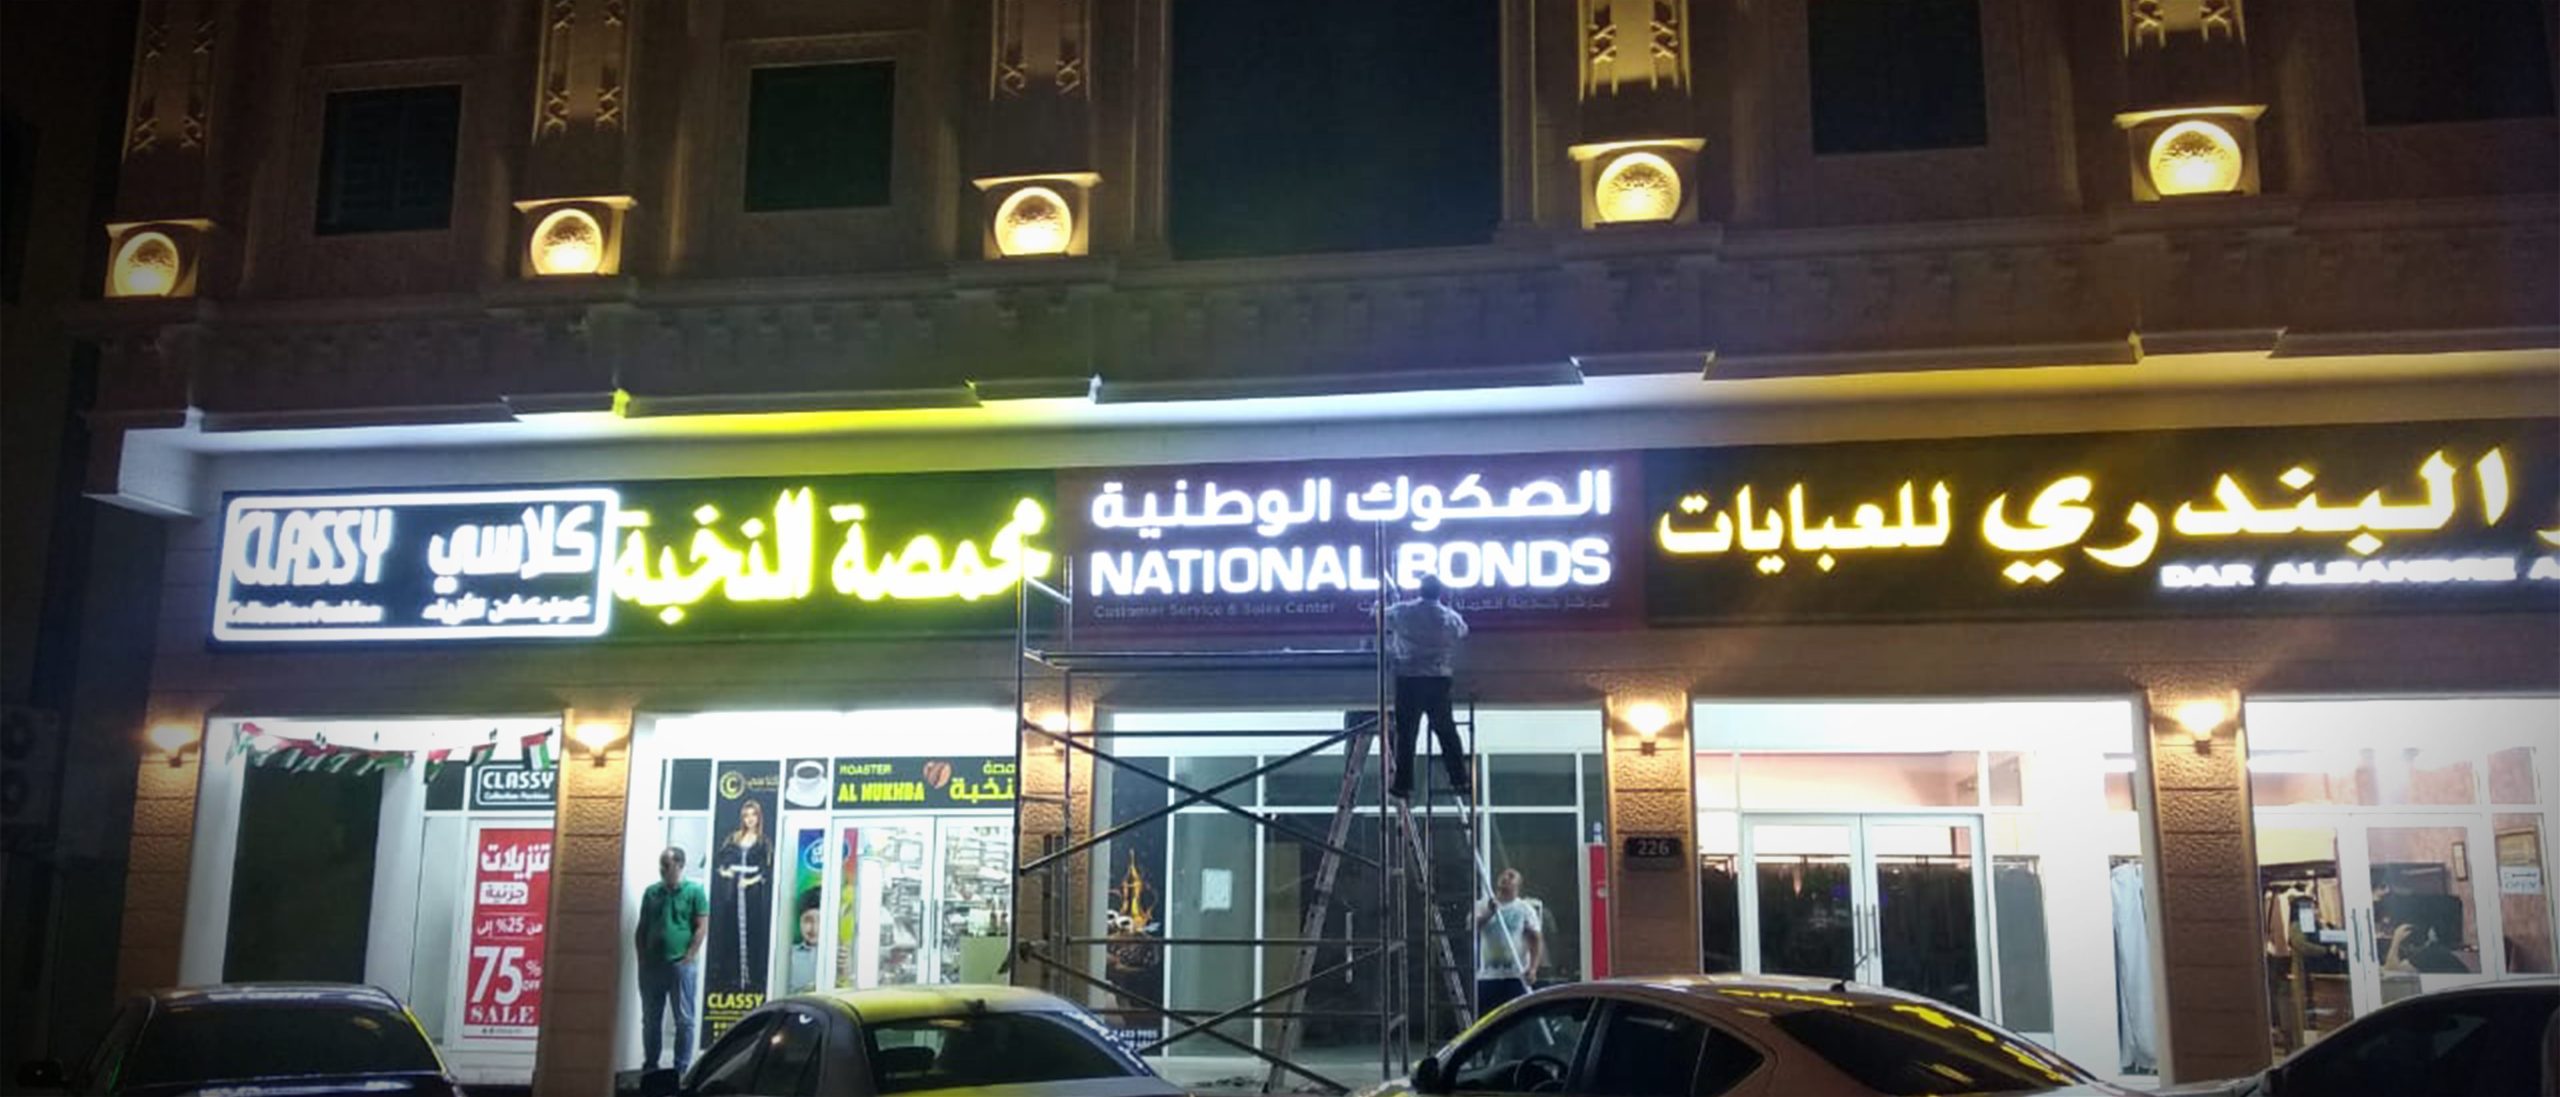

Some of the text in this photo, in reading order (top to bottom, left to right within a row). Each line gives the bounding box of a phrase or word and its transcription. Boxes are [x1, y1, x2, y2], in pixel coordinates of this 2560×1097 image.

[1091, 469, 1612, 539] الصكوك الوطنية
[1658, 447, 2510, 584] البندري للعبايات
[232, 508, 394, 586] CLASSY
[427, 505, 596, 594] كلاسي
[613, 486, 814, 625] النخبة
[1090, 537, 1611, 596] NATIONAL BONDS
[2159, 563, 2256, 588] DAR
[1093, 604, 1164, 619] Customer
[1169, 602, 1222, 616] Service
[1284, 600, 1335, 614] Center
[483, 771, 555, 789] CLASSY
[839, 763, 893, 776] ROASTER
[837, 782, 858, 802] AL
[1637, 840, 1671, 856] 226
[480, 843, 551, 880] تنزيلات
[471, 946, 525, 1005] 75
[525, 960, 542, 977] %
[522, 980, 540, 991] OFF
[707, 992, 764, 1009] CLASSY
[471, 1005, 535, 1023] SALE
